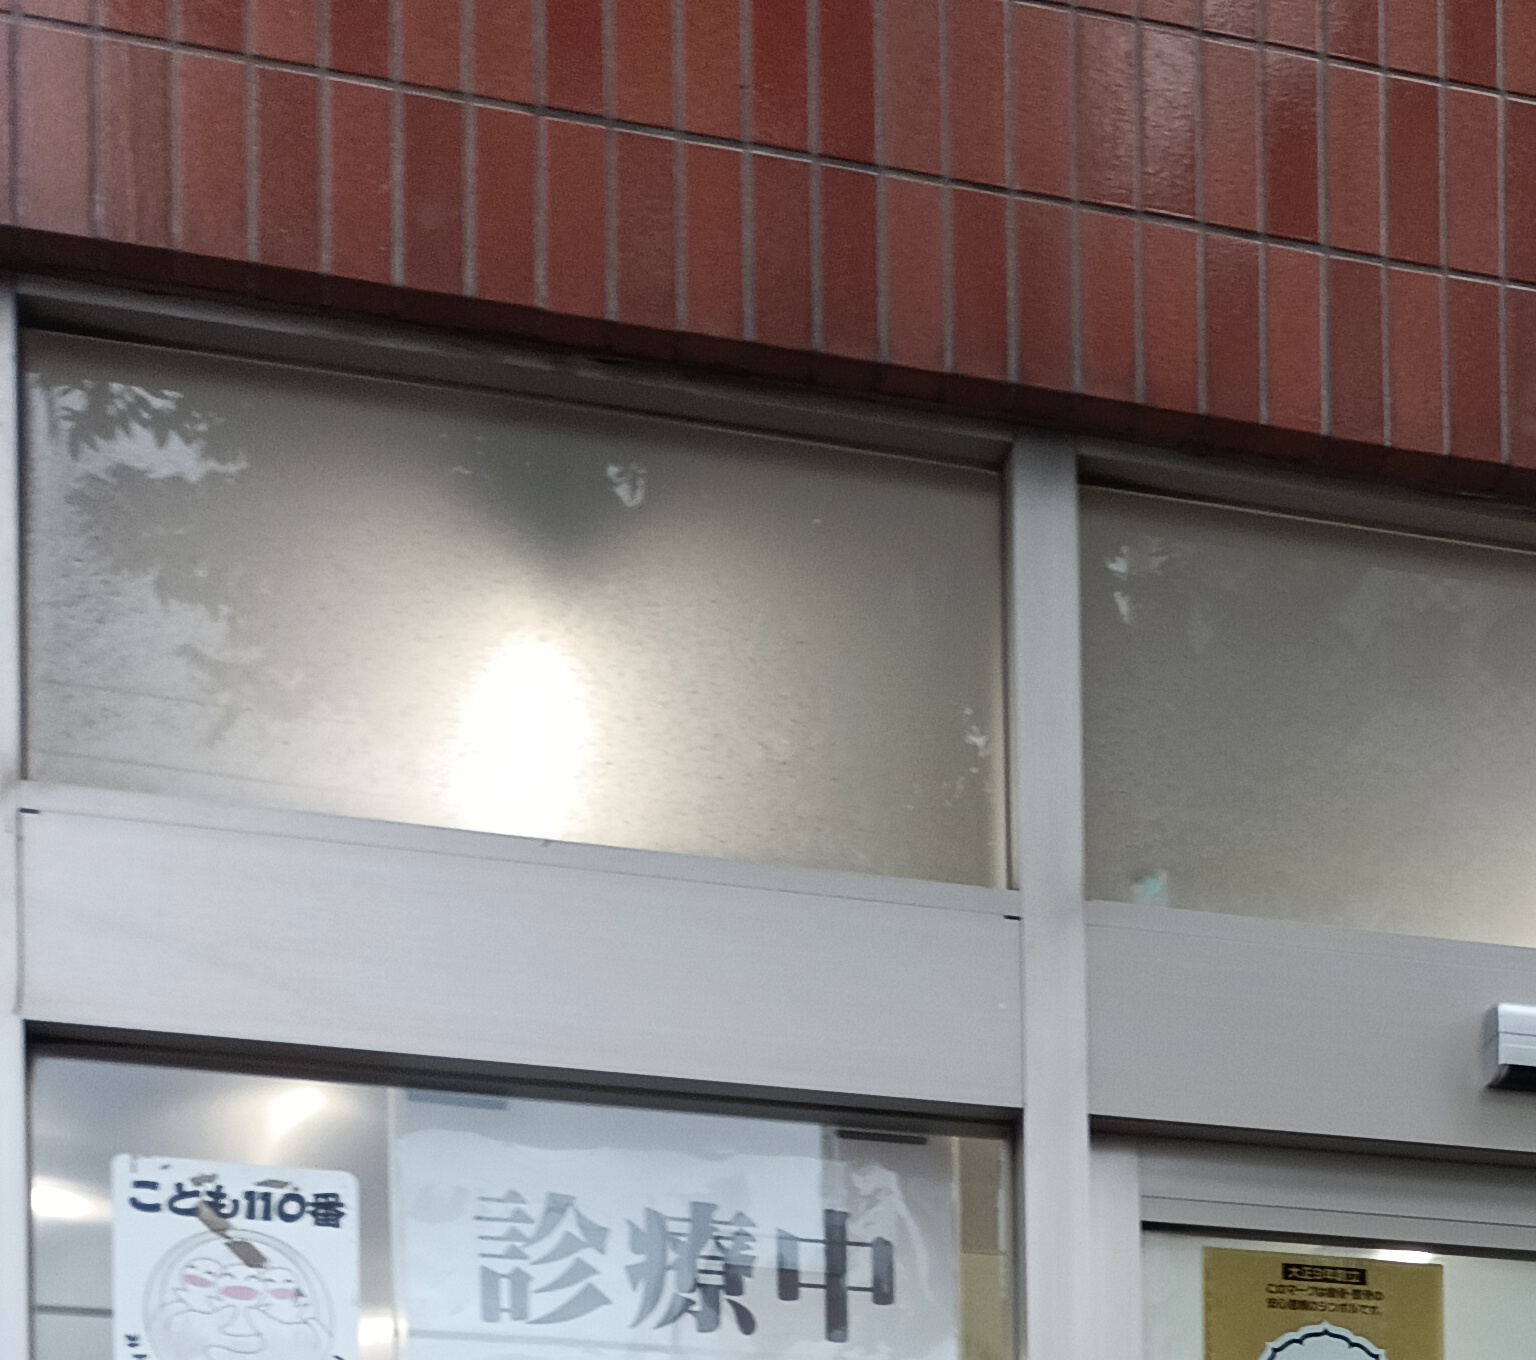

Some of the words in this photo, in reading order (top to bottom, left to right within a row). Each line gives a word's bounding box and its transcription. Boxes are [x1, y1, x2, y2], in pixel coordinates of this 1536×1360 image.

[129, 1180, 346, 1229] こども110番
[473, 1190, 895, 1343] 診療中
